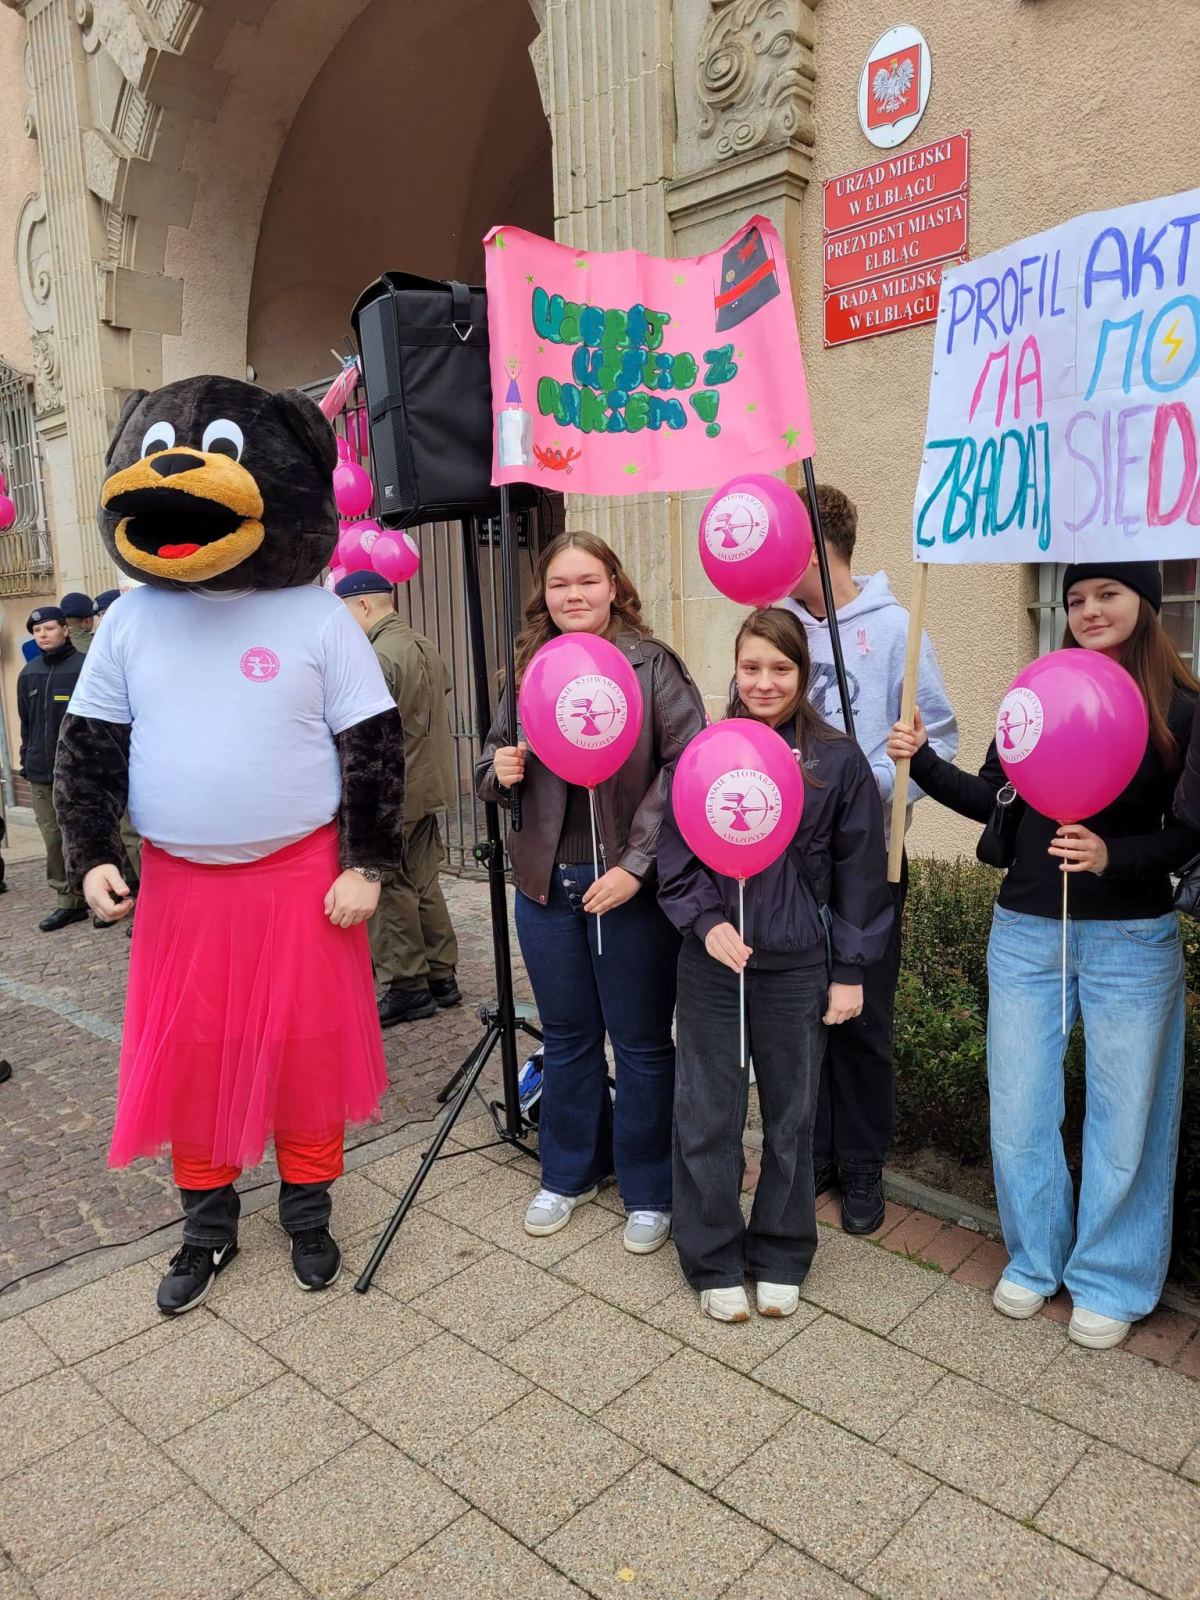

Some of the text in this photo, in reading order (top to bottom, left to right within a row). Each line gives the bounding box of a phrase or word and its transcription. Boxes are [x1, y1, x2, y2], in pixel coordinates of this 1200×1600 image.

[835, 142, 953, 197] URZĄD MIEJSKI
[848, 174, 937, 217] W ELBLĄGU
[827, 203, 963, 260] PREZYDENT MIASTA
[865, 240, 920, 272] ELBLĄG
[838, 286, 878, 311] RADA
[848, 294, 936, 331] W ELBLĄGU
[916, 422, 1051, 551] ZBADAJ
[1146, 401, 1200, 528] D
